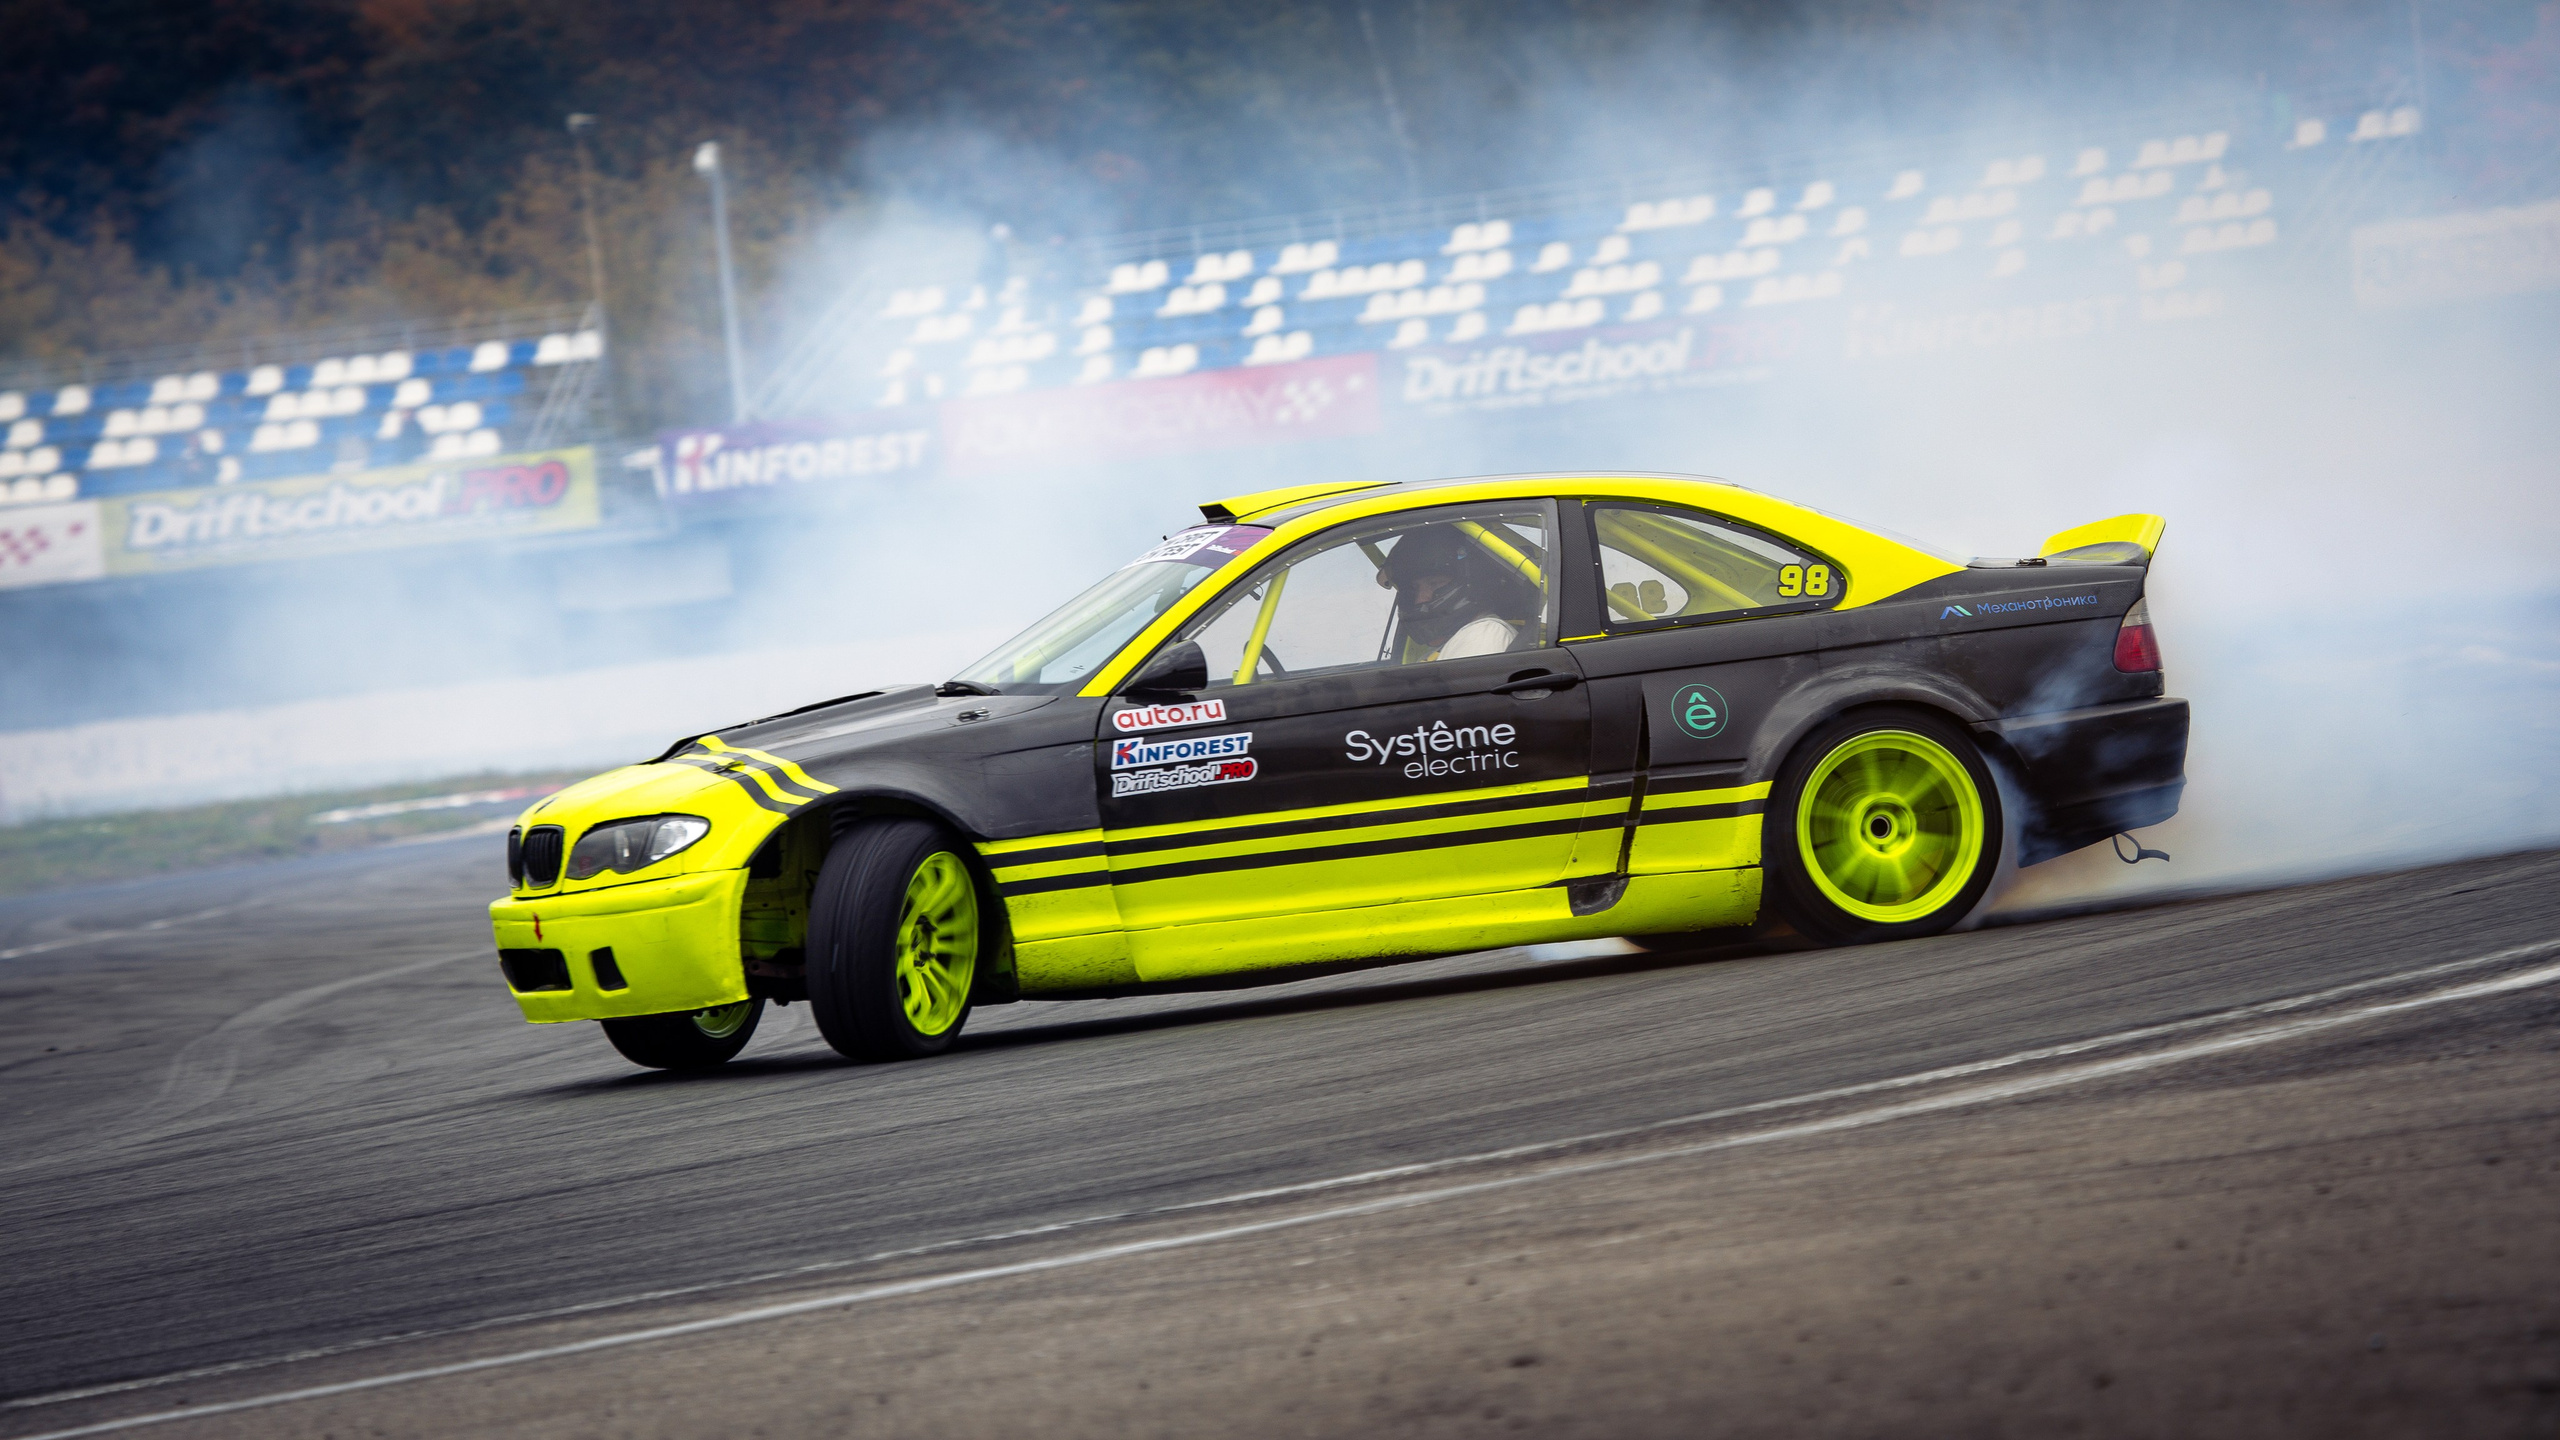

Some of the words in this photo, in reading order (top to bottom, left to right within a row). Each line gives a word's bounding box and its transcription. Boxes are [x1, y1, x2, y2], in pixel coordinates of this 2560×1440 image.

[673, 430, 930, 495] KINFOREST
[1777, 563, 1830, 598] 98
[1976, 595, 2098, 615] Механотроника
[1117, 702, 1223, 729] auto.ru
[1115, 735, 1249, 766] KINFOREST
[1345, 719, 1517, 765] Systême
[1403, 748, 1520, 779] electric
